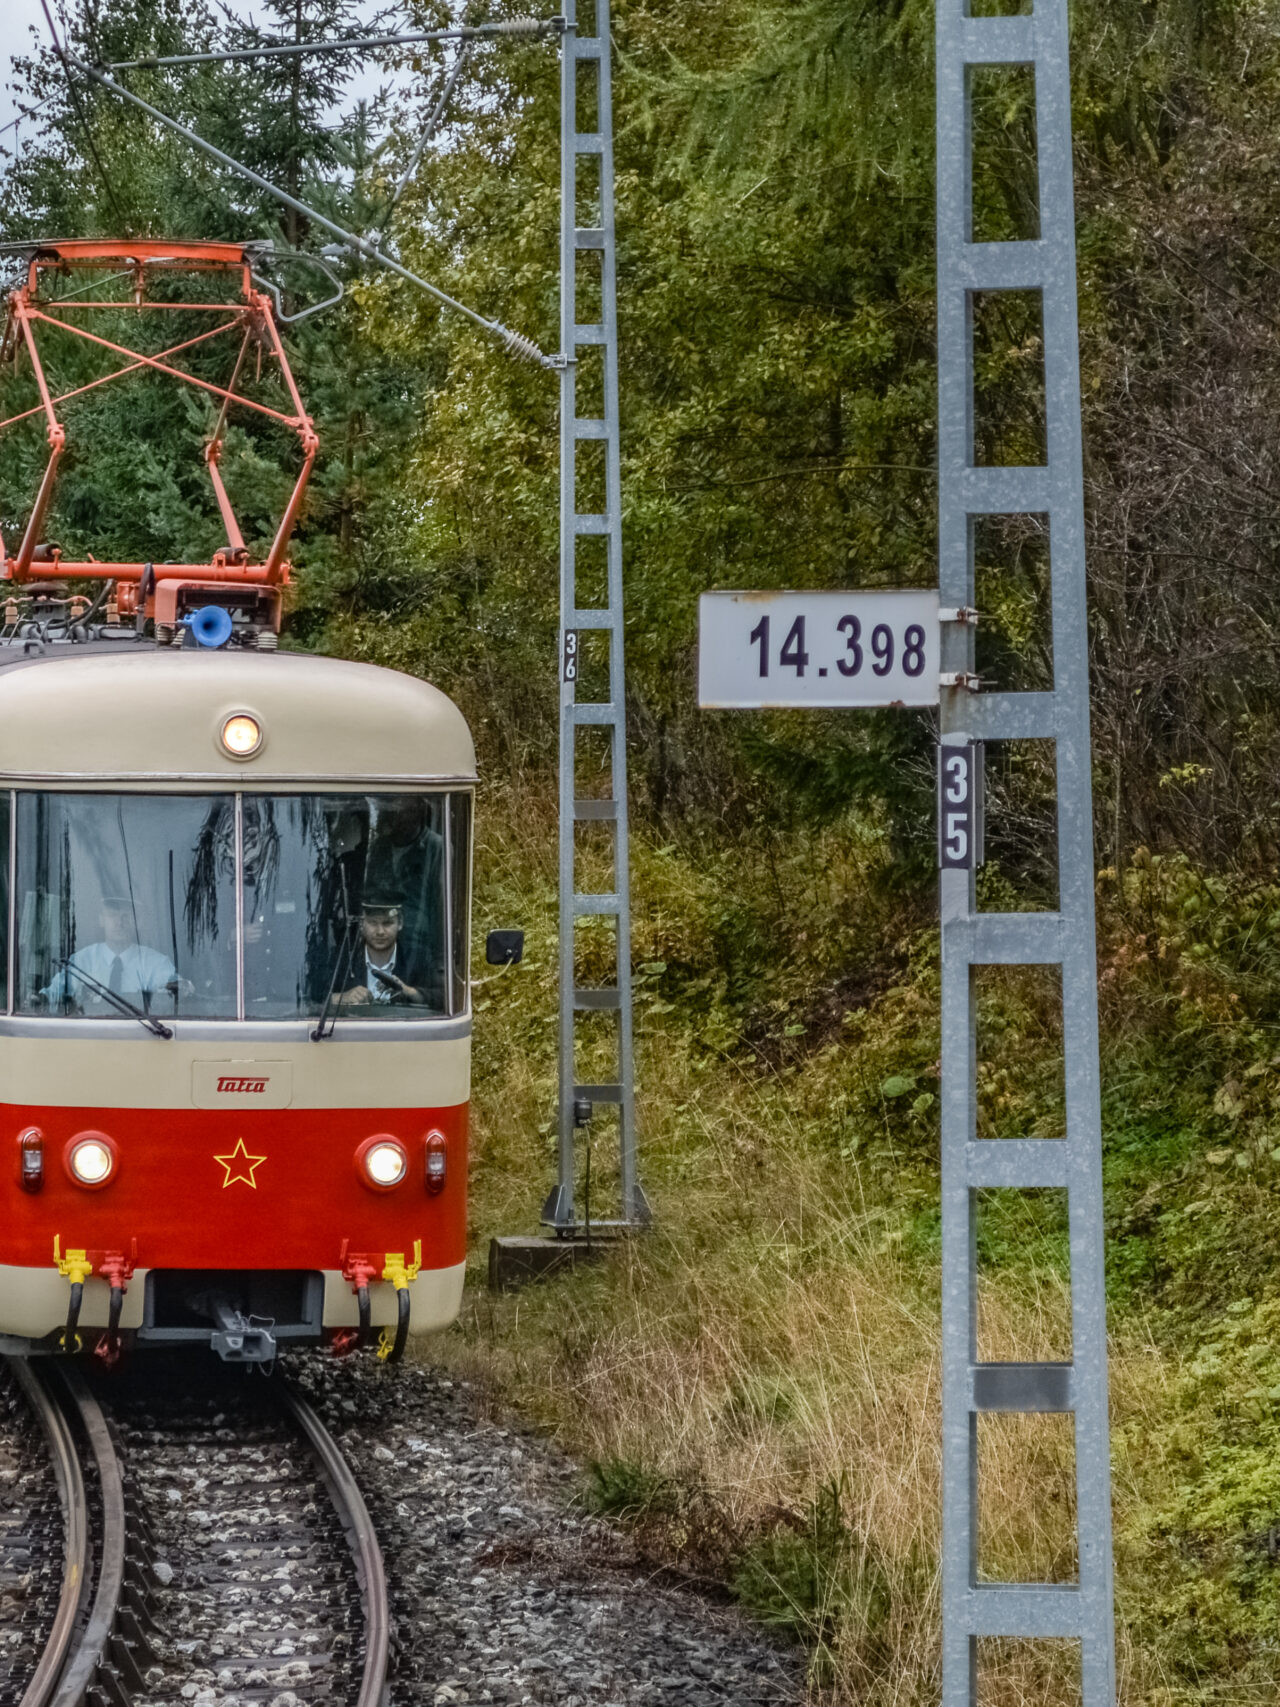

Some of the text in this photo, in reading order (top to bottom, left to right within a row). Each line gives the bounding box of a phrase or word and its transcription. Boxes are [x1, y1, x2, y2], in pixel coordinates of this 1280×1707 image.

[565, 632, 577, 679] 36
[749, 614, 927, 678] 14.398
[945, 755, 969, 861] 35
[216, 1076, 270, 1093] Tatra
